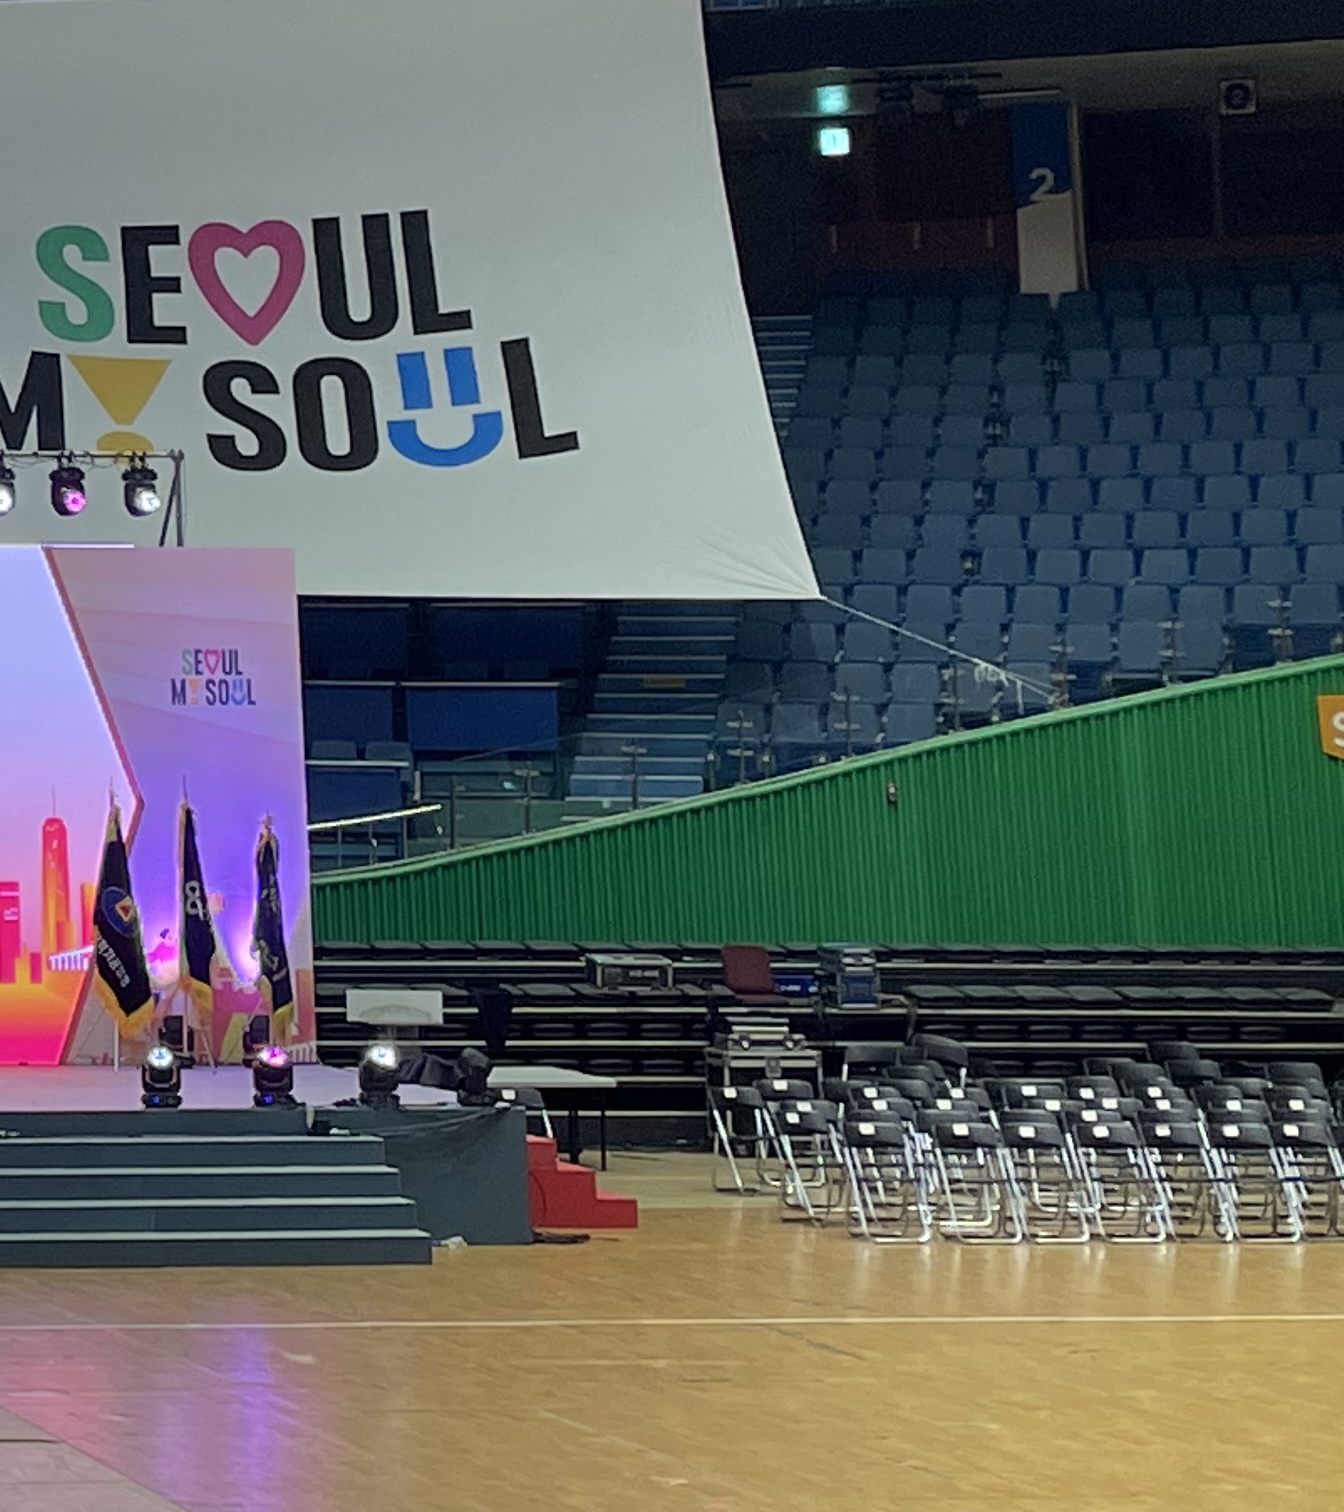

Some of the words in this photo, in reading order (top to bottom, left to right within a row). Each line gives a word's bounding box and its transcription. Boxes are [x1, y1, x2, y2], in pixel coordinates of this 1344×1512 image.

[1028, 167, 1055, 202] 2
[201, 336, 581, 473] SOUL
[205, 678, 256, 705] SOUL
